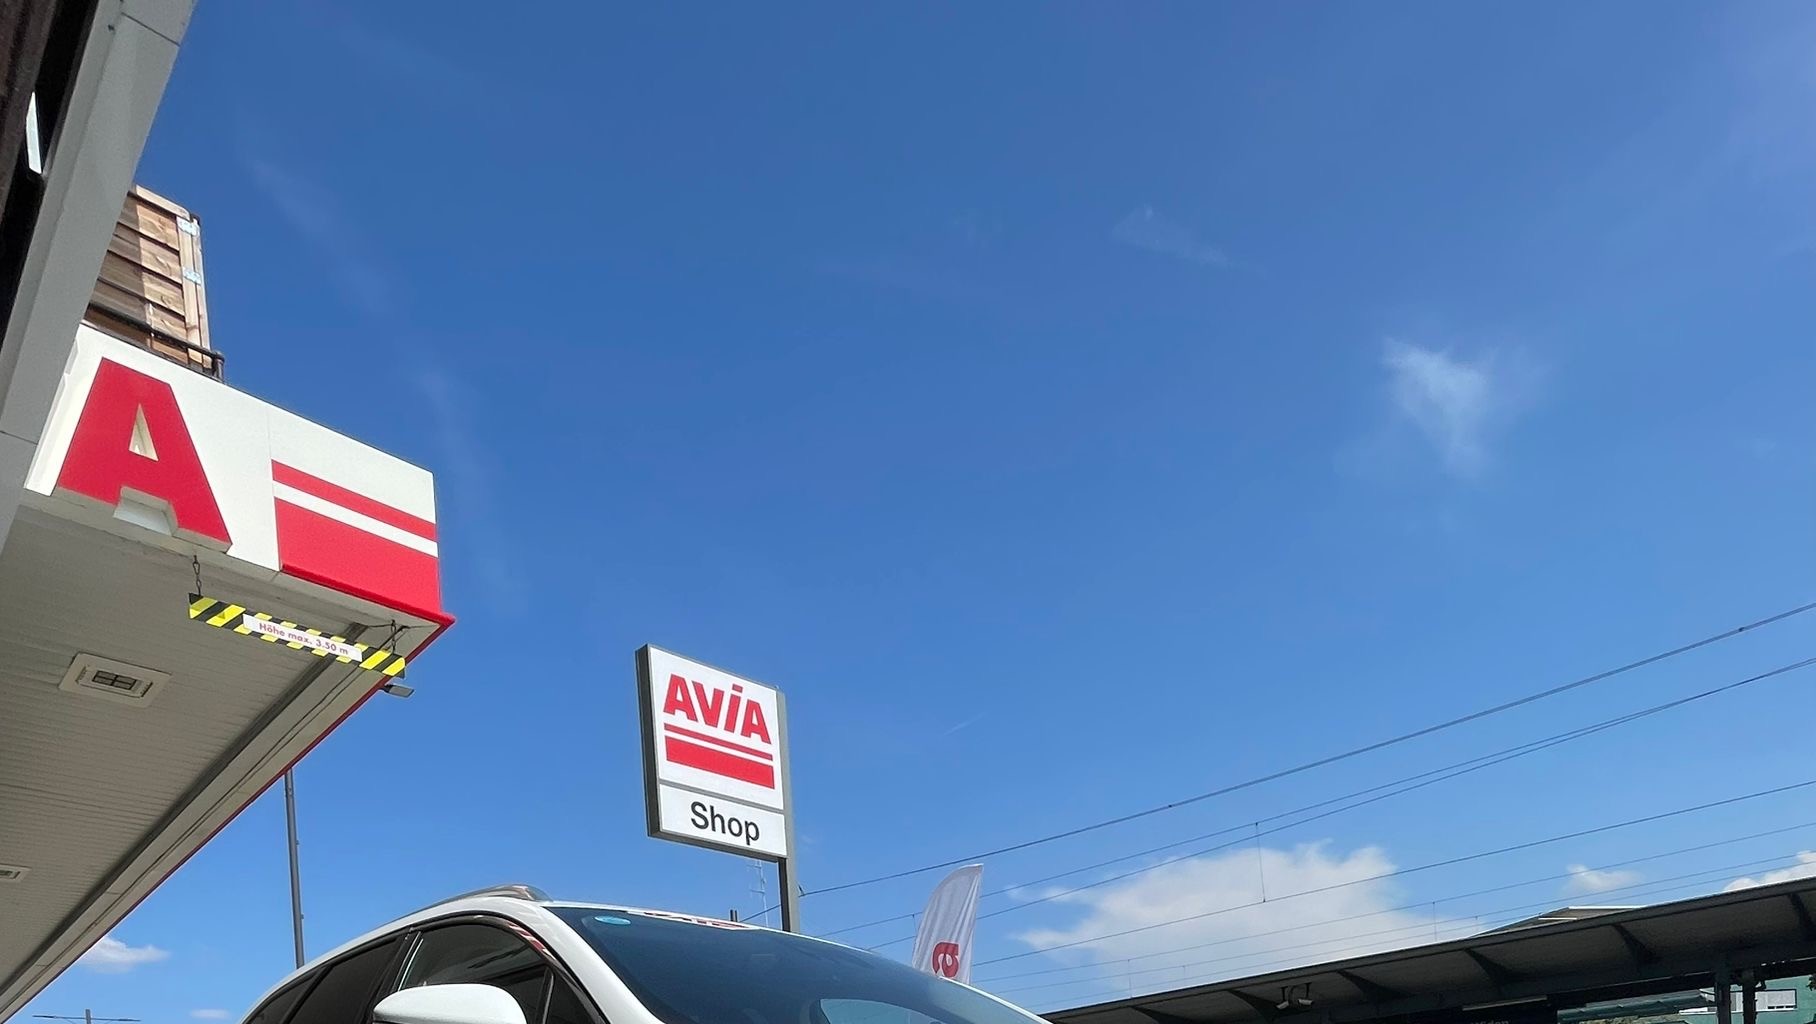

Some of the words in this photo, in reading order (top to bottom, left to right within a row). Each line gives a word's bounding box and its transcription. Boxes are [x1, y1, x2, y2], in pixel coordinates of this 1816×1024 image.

[57, 357, 232, 546] A
[259, 622, 285, 637] Höhe
[339, 647, 348, 655] m
[690, 801, 760, 846] Shop
